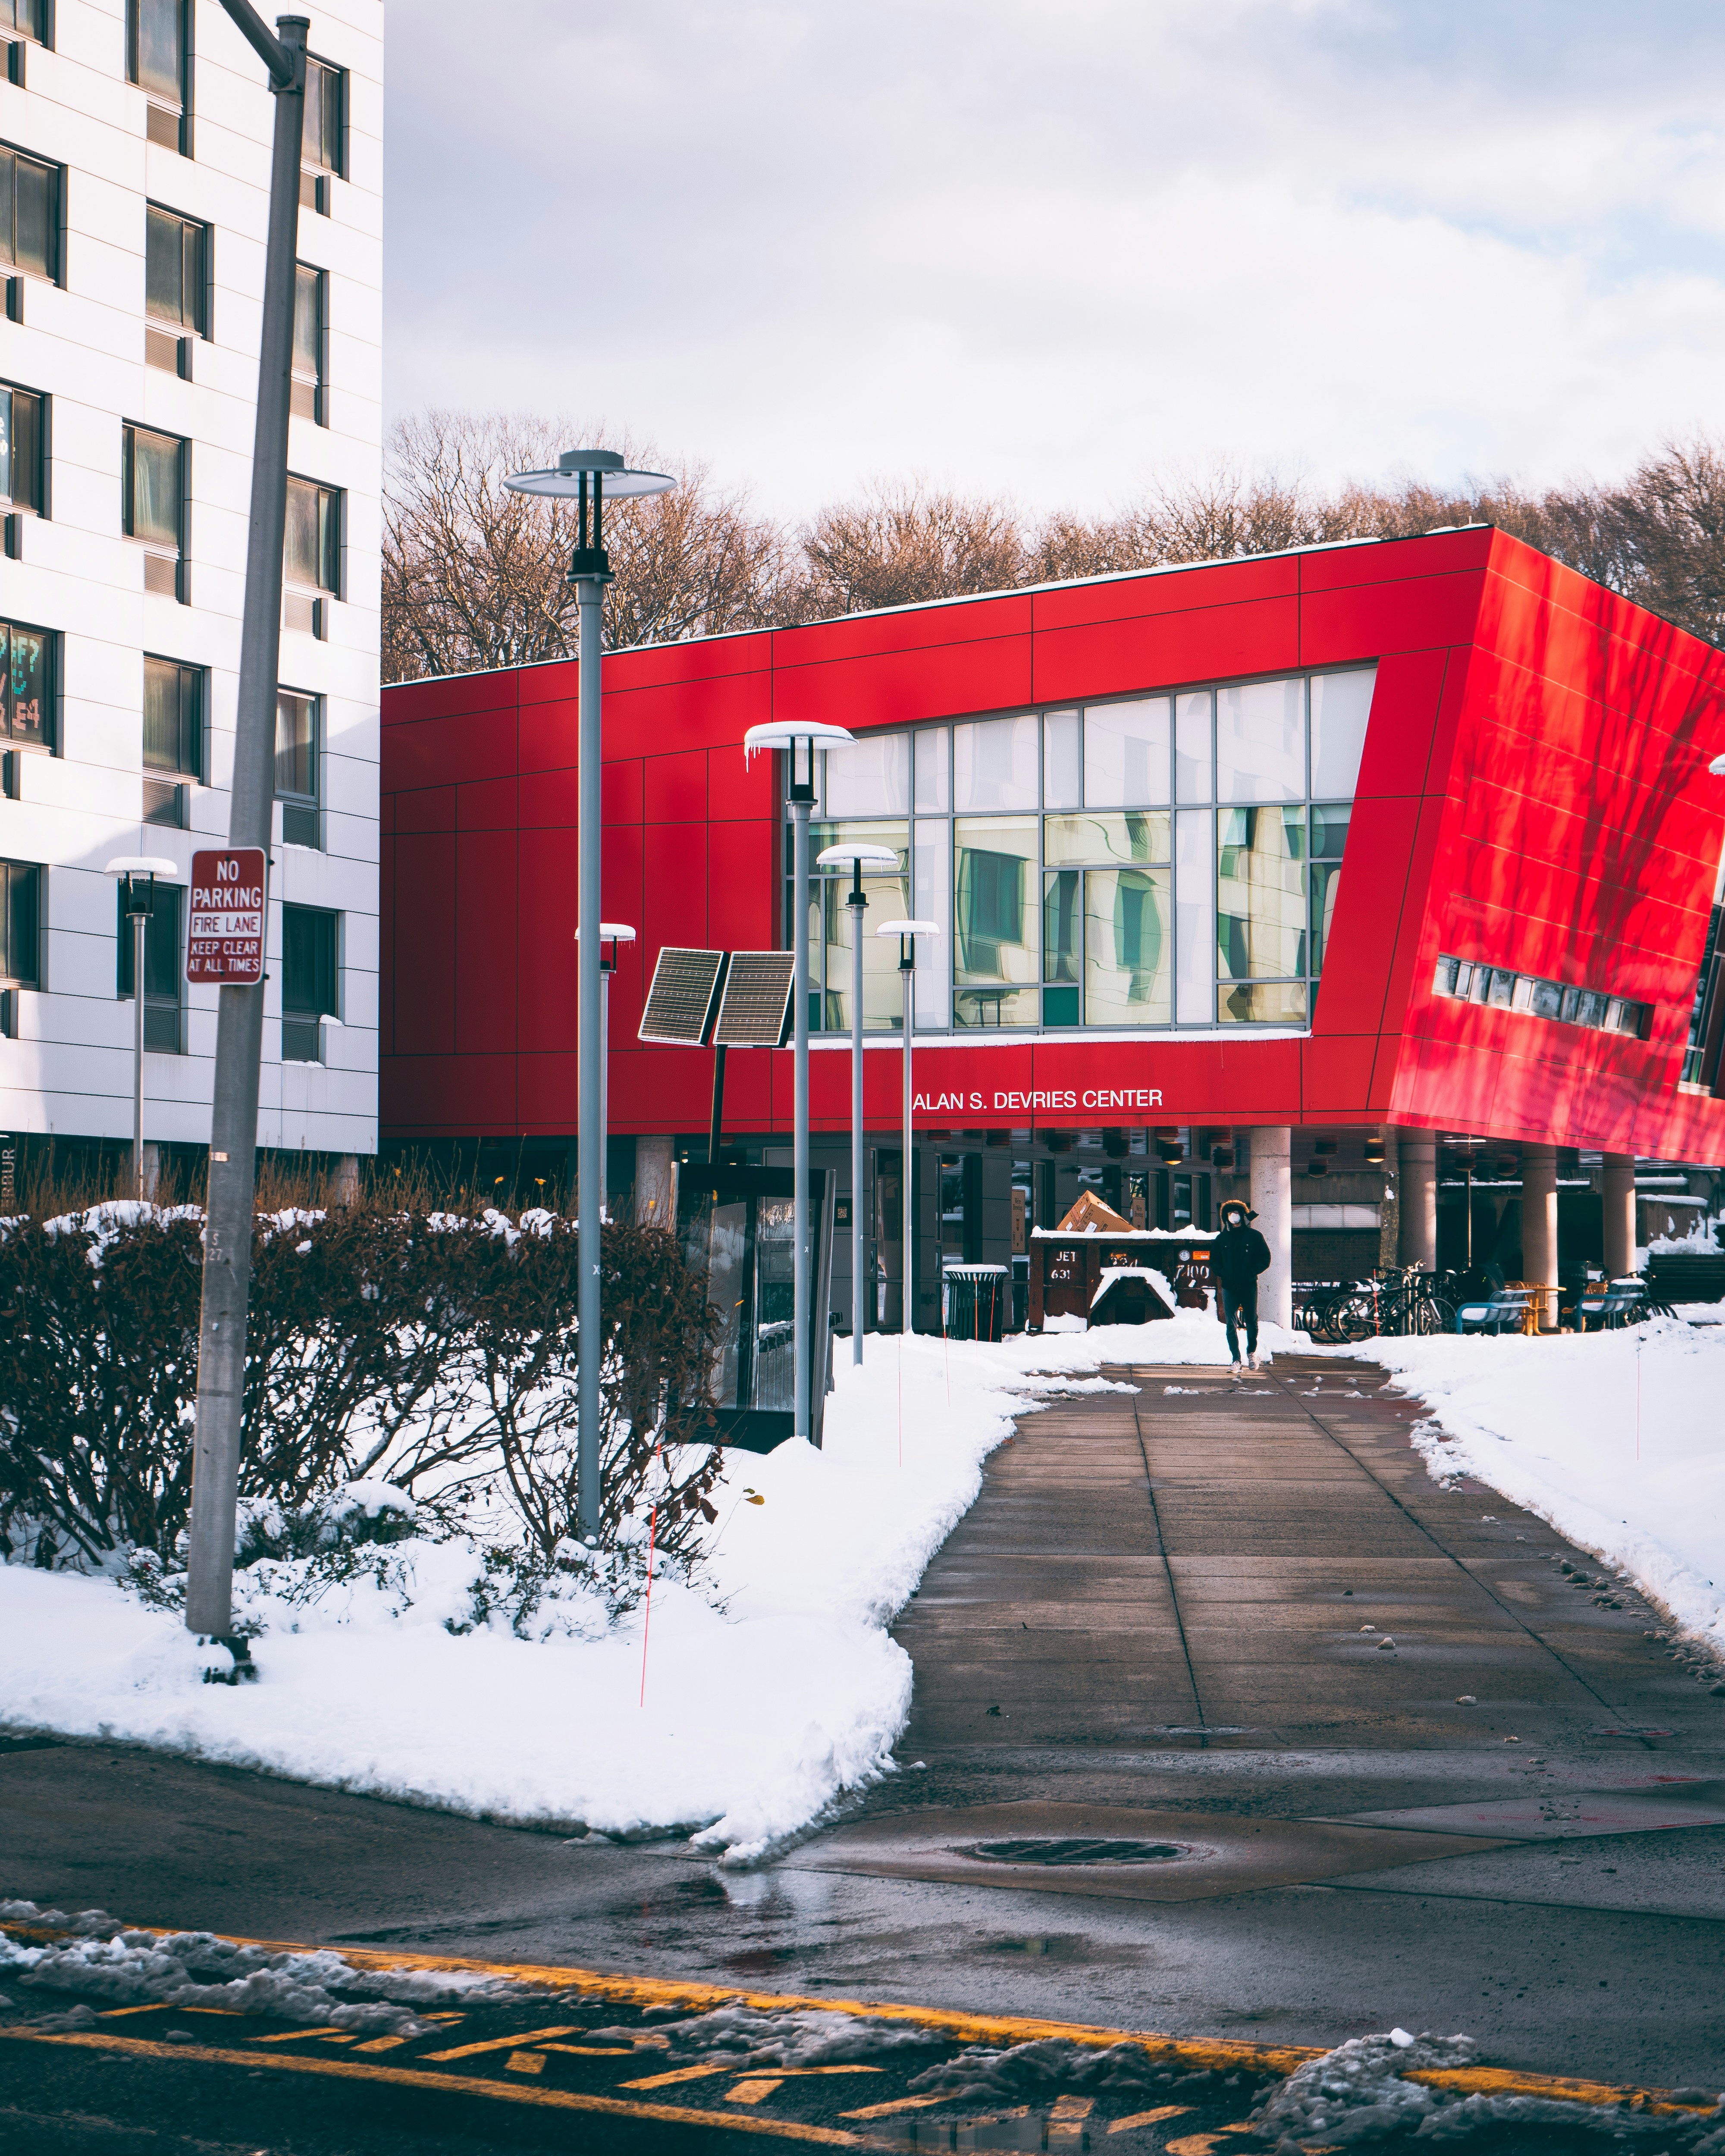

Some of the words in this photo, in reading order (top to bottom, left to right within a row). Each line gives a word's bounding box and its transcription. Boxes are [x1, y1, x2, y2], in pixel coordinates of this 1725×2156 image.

[216, 860, 240, 881] NO
[192, 887, 262, 908] PARKING
[194, 917, 220, 933] FIRE
[226, 916, 259, 933] LANE
[191, 941, 220, 955] KEEP
[223, 940, 259, 955] CLEAR
[188, 959, 201, 972] AT
[204, 959, 223, 972] ALL
[228, 958, 260, 972] TIMES
[913, 1093, 963, 1110] ALAN
[969, 1092, 987, 1109] S.
[994, 1091, 1077, 1109] DEVRIES
[1082, 1089, 1163, 1108] CENTER
[212, 1233, 219, 1245] S
[209, 1248, 223, 1260] 27
[1056, 1251, 1076, 1262] JET
[1051, 1269, 1070, 1279] 631
[1176, 1264, 1210, 1279] 7100
